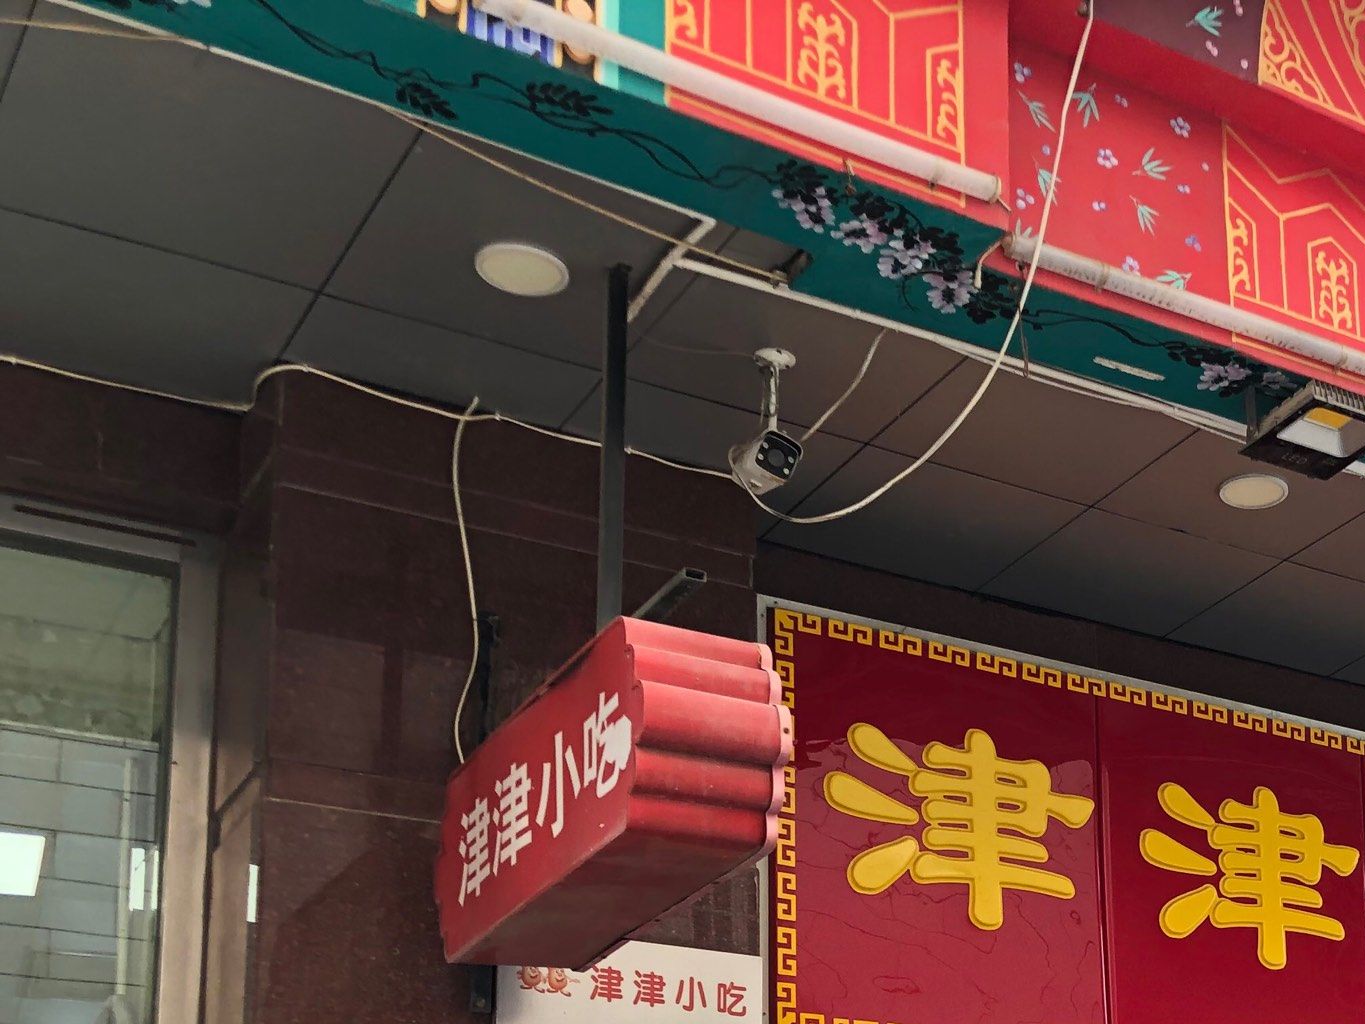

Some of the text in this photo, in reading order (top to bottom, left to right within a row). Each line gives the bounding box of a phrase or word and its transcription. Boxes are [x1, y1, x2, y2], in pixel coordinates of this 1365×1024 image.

[458, 691, 632, 907] 津津小吃
[589, 963, 748, 1018] 津津小吃
